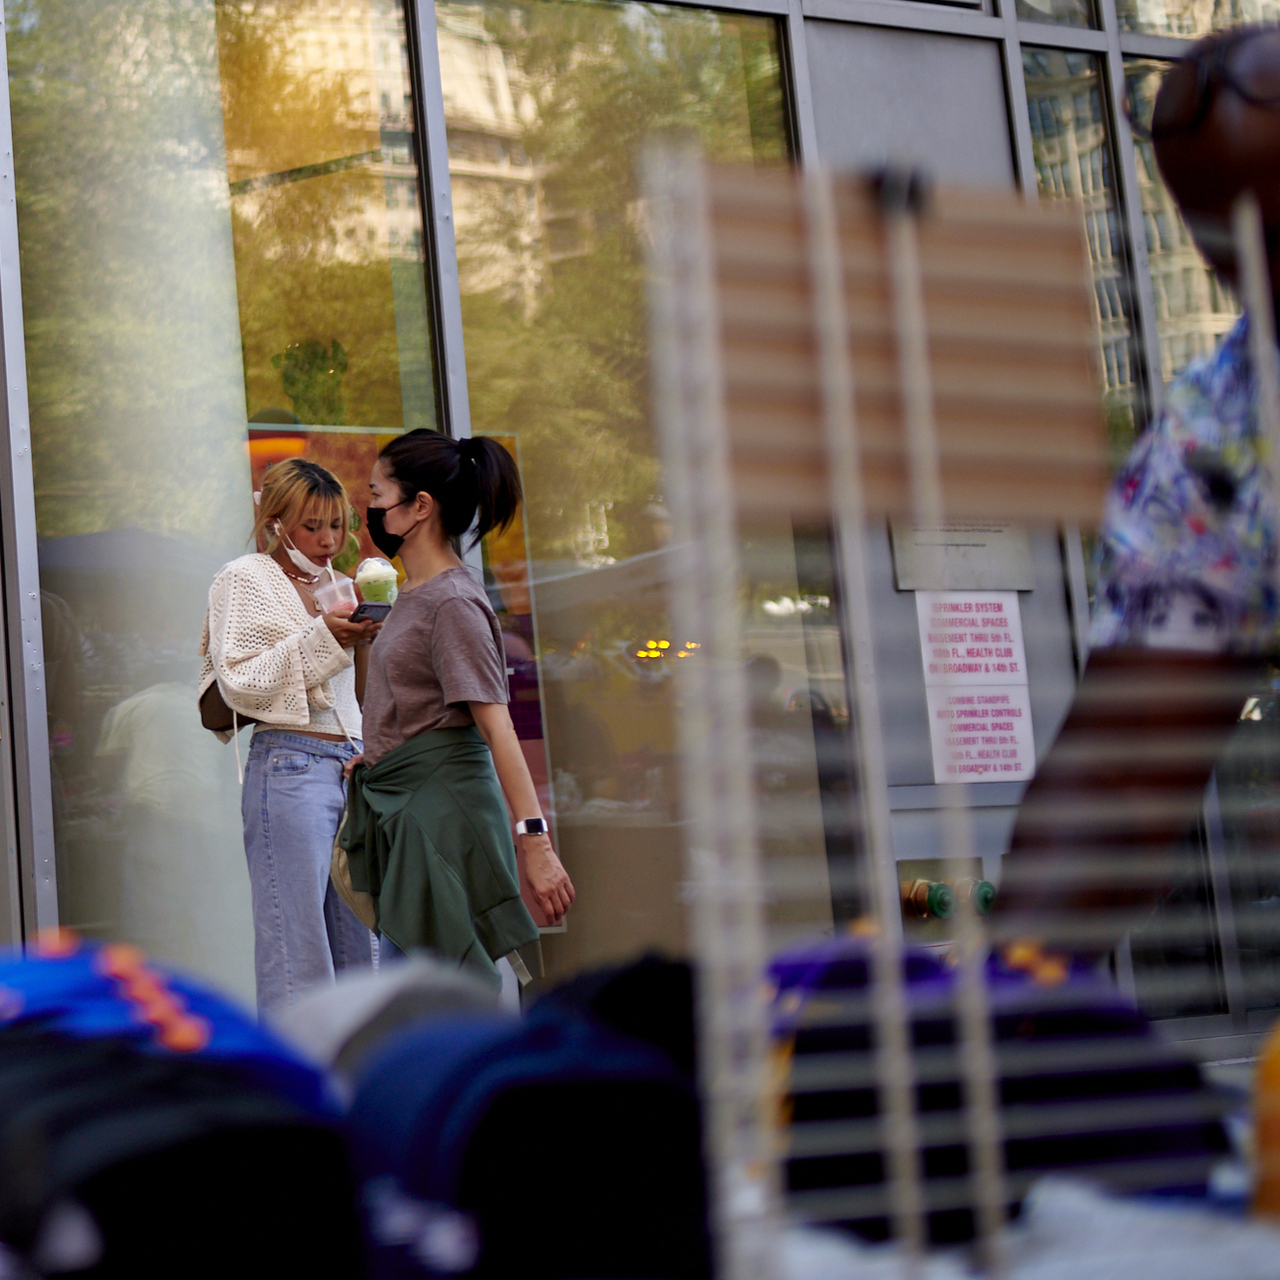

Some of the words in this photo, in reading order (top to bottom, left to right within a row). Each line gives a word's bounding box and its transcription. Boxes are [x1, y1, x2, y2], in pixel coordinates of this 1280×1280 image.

[931, 603, 973, 613] SPRINKLER
[975, 603, 1003, 612] SYSTEM
[981, 617, 1009, 627] SPACES
[970, 633, 989, 643] THRU
[966, 648, 993, 658] HEALTH
[995, 648, 1013, 658] CLUB
[943, 663, 983, 673] BROADWAY
[985, 663, 990, 673] &
[992, 663, 1008, 673] 14th
[956, 709, 990, 718] SPRINKLER
[991, 709, 1022, 717] CONTROLS
[949, 723, 990, 732] COMMERCIAL
[991, 722, 1014, 731] SPACES
[981, 736, 997, 745] THRU
[978, 750, 1001, 759] HEALTH
[1002, 749, 1018, 758] CLUB
